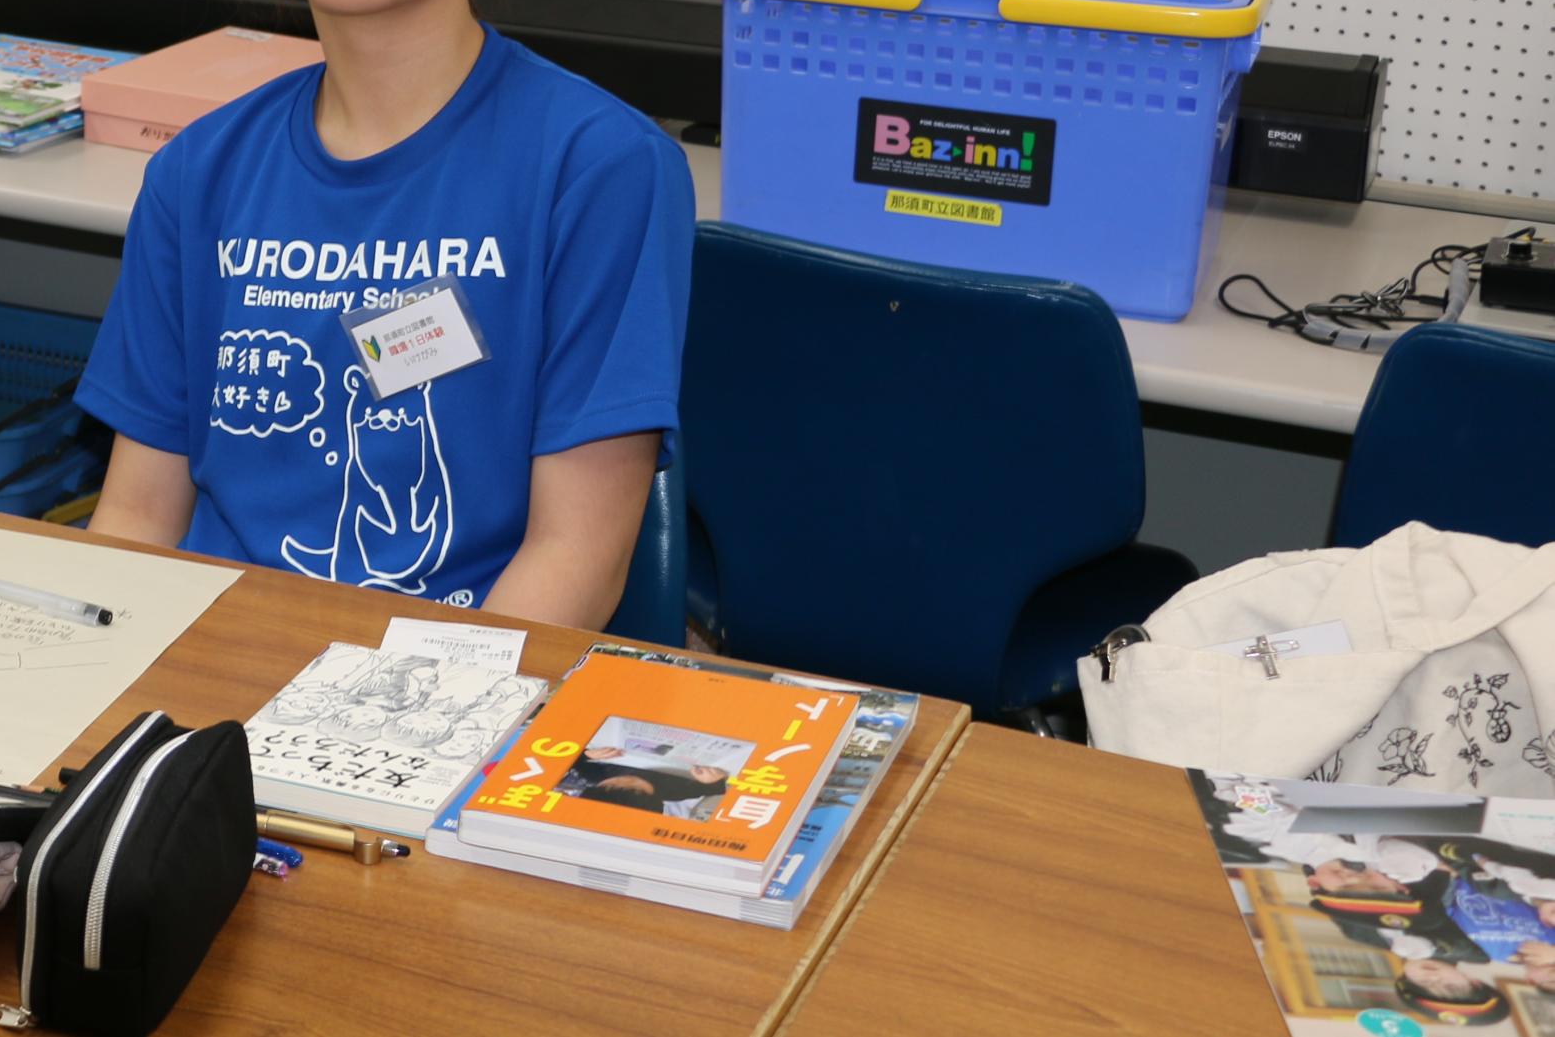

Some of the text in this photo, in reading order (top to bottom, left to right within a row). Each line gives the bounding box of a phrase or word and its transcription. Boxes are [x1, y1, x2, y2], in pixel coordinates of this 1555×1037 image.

[919, 119, 1011, 137] FOR DELIGHTFUL HUMAN LIFE
[1267, 129, 1302, 142] EPSON
[890, 195, 997, 222] 那須町立図書館
[217, 236, 507, 281] KURODAHARA
[243, 285, 355, 313] Elementary
[248, 744, 421, 790] 友だちって
[264, 729, 430, 772] なんだろう?
[476, 735, 581, 814] ぼくの
